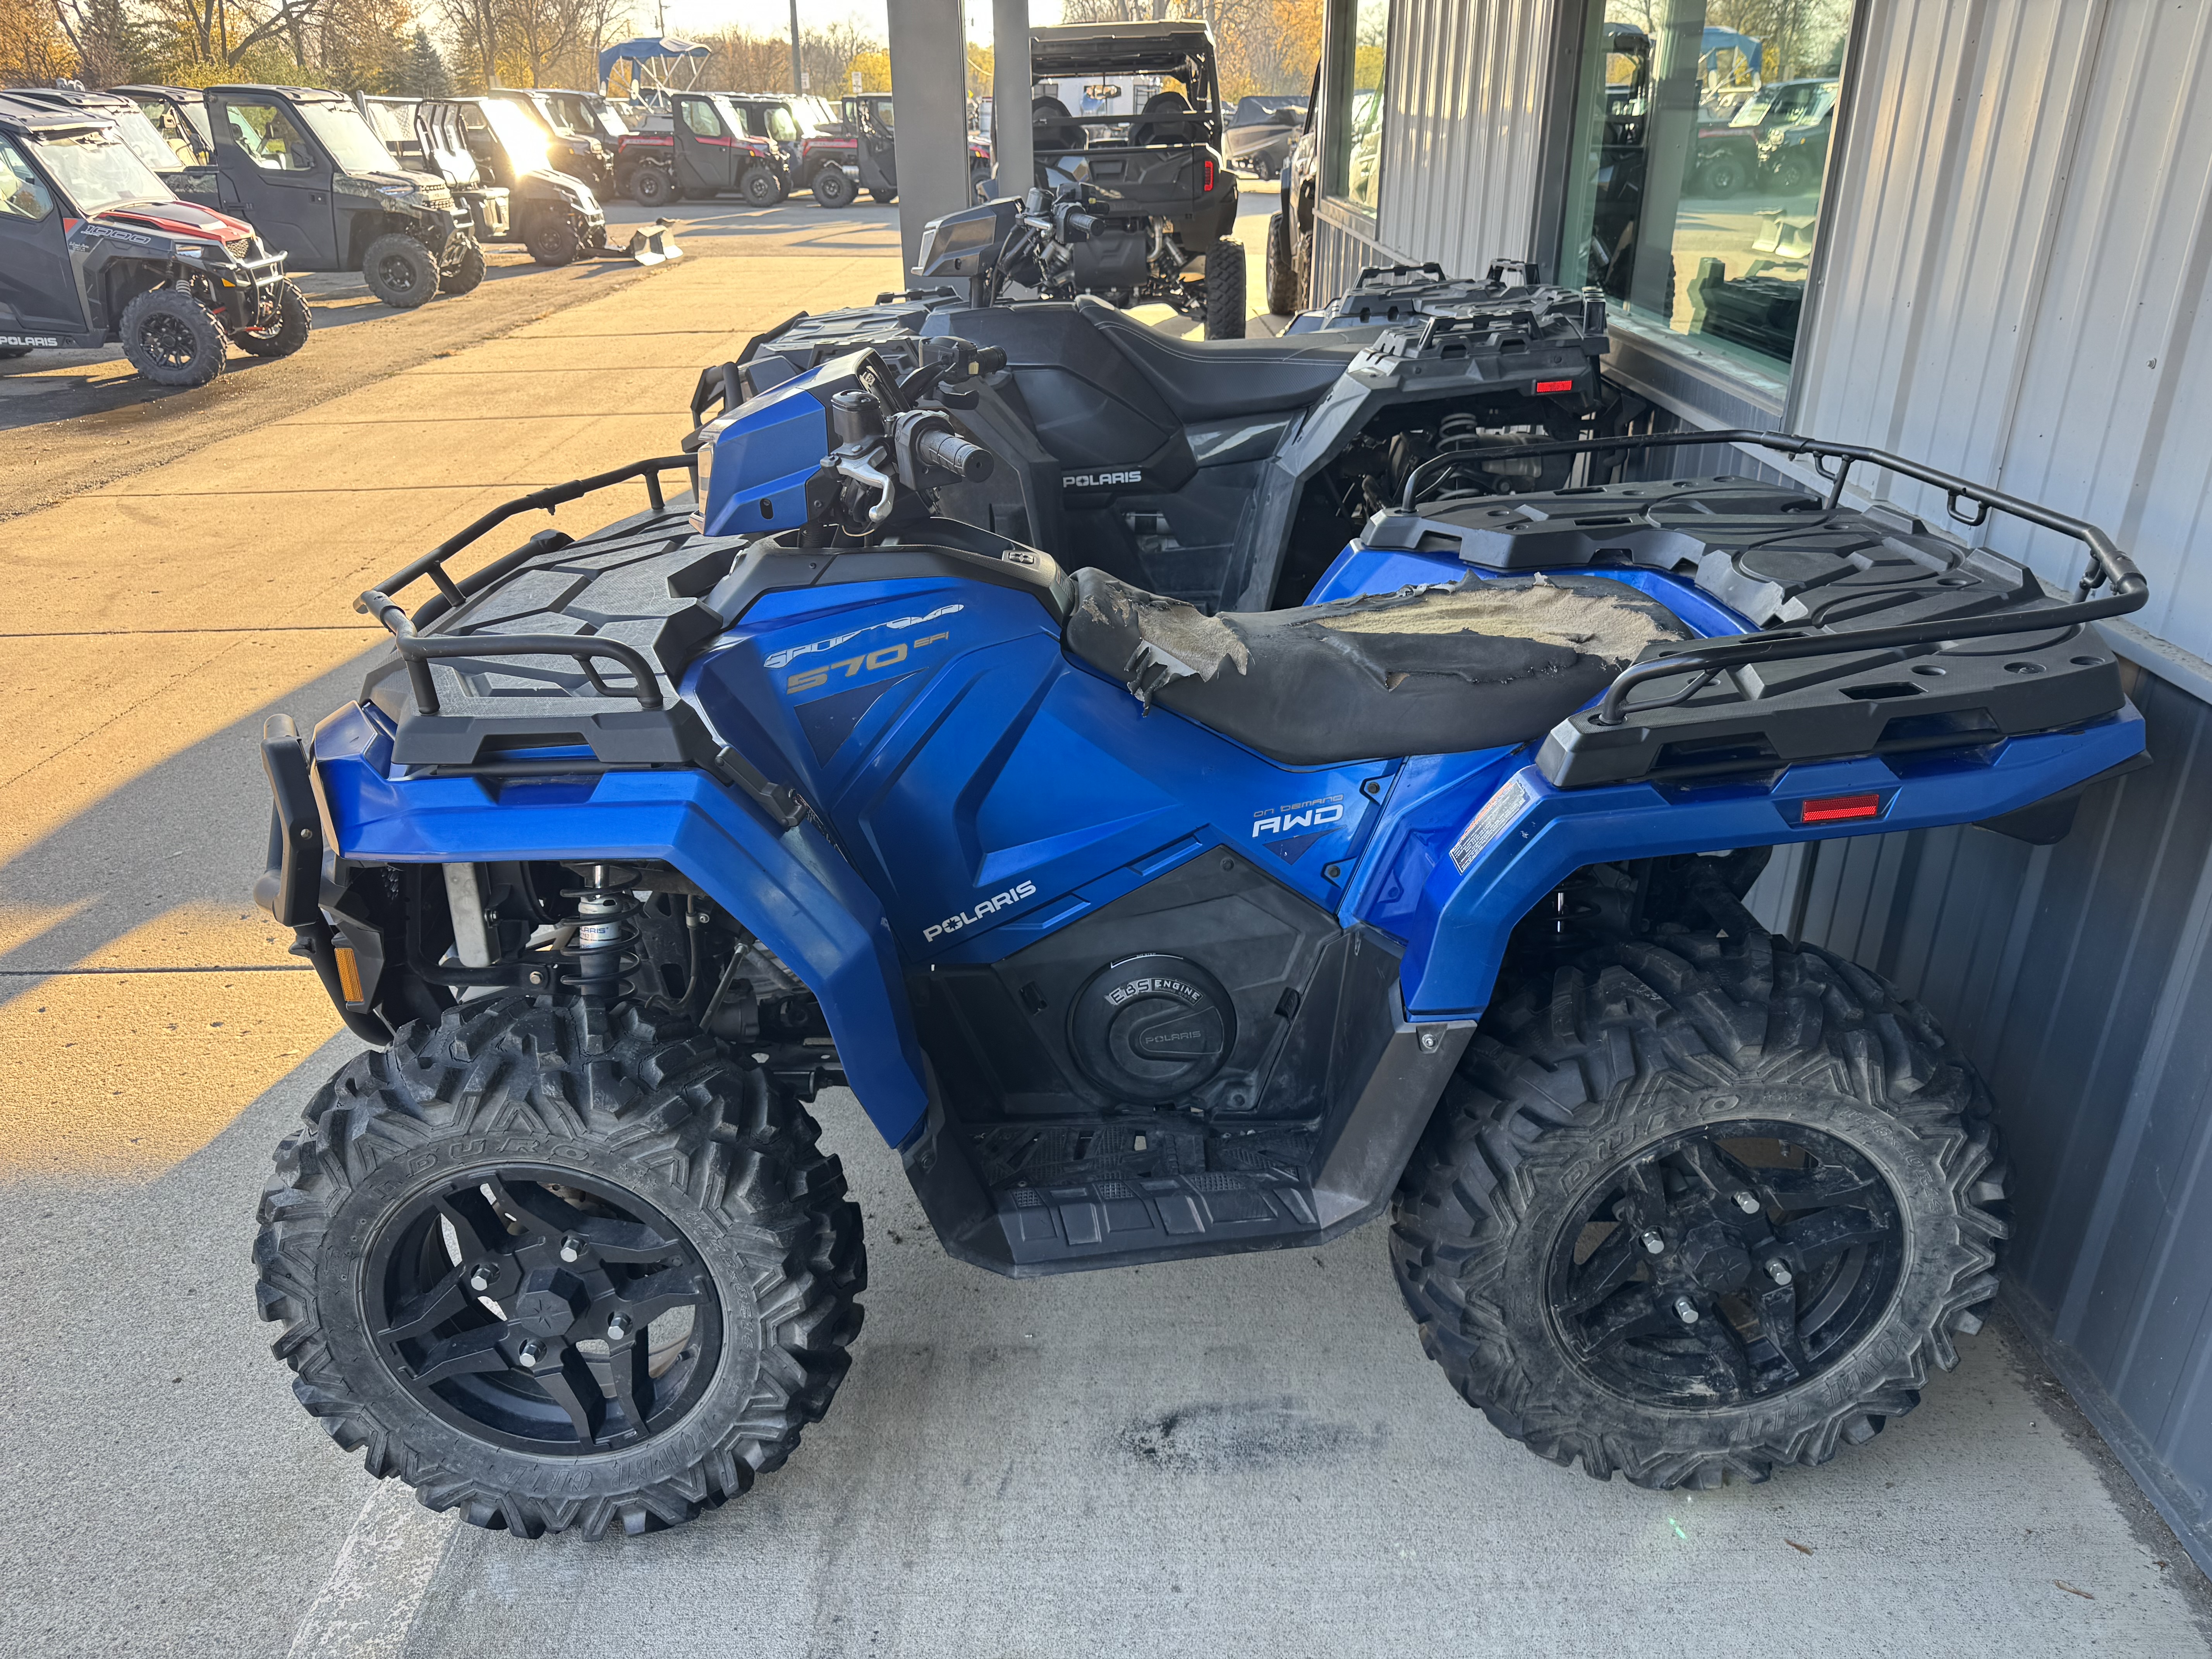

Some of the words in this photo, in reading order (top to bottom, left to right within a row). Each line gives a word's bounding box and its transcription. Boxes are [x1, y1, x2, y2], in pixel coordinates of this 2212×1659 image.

[85, 225, 151, 244] 1000
[0, 336, 58, 346] POLARIS
[1063, 471, 1142, 488] POLARIS
[787, 643, 908, 695] 570
[914, 631, 950, 648] EFI
[1254, 808, 1274, 817] ON
[1280, 794, 1344, 812] DEMAND
[1252, 804, 1344, 838] AWD
[923, 880, 1036, 942] POLARIS
[1110, 980, 1149, 1003] EBS
[1154, 979, 1200, 1000] ENGINE
[1145, 1030, 1201, 1044] POLARIS
[407, 1138, 589, 1177] DURO
[1825, 1319, 1916, 1408] POWER
[610, 1417, 714, 1488] POWER
[499, 1465, 593, 1492] GRIP
